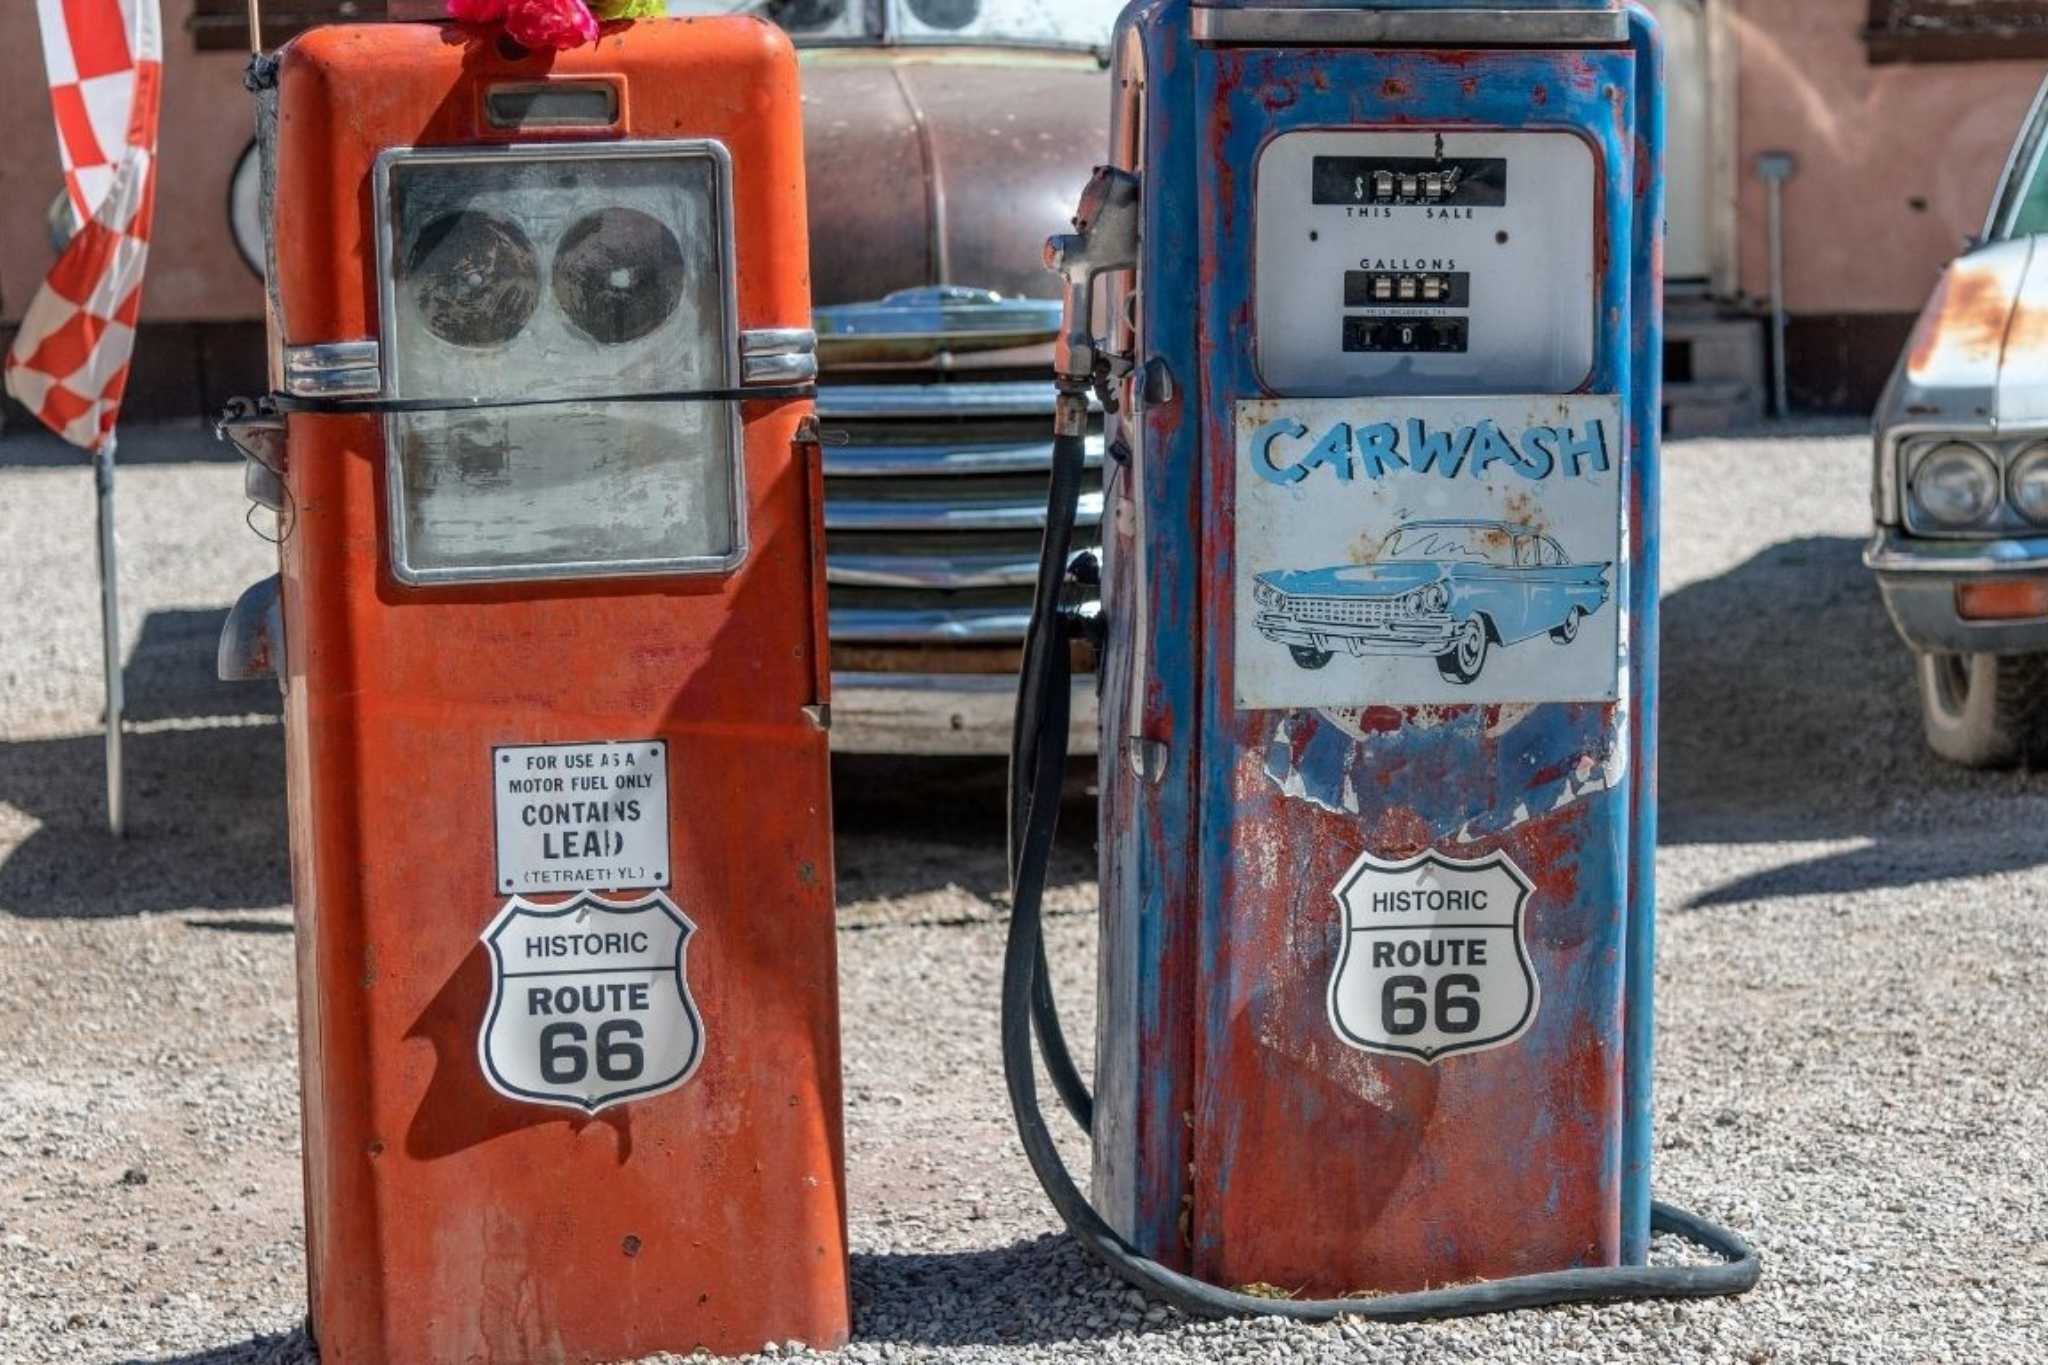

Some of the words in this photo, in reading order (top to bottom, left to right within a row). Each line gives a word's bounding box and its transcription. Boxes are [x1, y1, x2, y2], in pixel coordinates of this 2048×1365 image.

[1346, 207, 1392, 218] THIS
[1426, 207, 1474, 219] SALE
[1359, 258, 1456, 270] GALLONS
[1250, 417, 1610, 486] CARWASH
[526, 756, 557, 771] FOR
[565, 754, 594, 769] USE
[600, 753, 621, 767] AS
[625, 752, 636, 766] A
[509, 778, 564, 793] MOTOR
[571, 776, 609, 791] FUEL
[616, 774, 653, 789] ONLY
[521, 800, 641, 827] CONTAINS
[543, 830, 625, 860] LEAD
[1372, 890, 1488, 912] HISTORIC
[526, 932, 648, 958] HISTORIC
[1372, 939, 1487, 968] ROUTE
[528, 982, 650, 1015] ROUTE
[1381, 973, 1481, 1035] 66
[540, 1018, 644, 1084] 66
